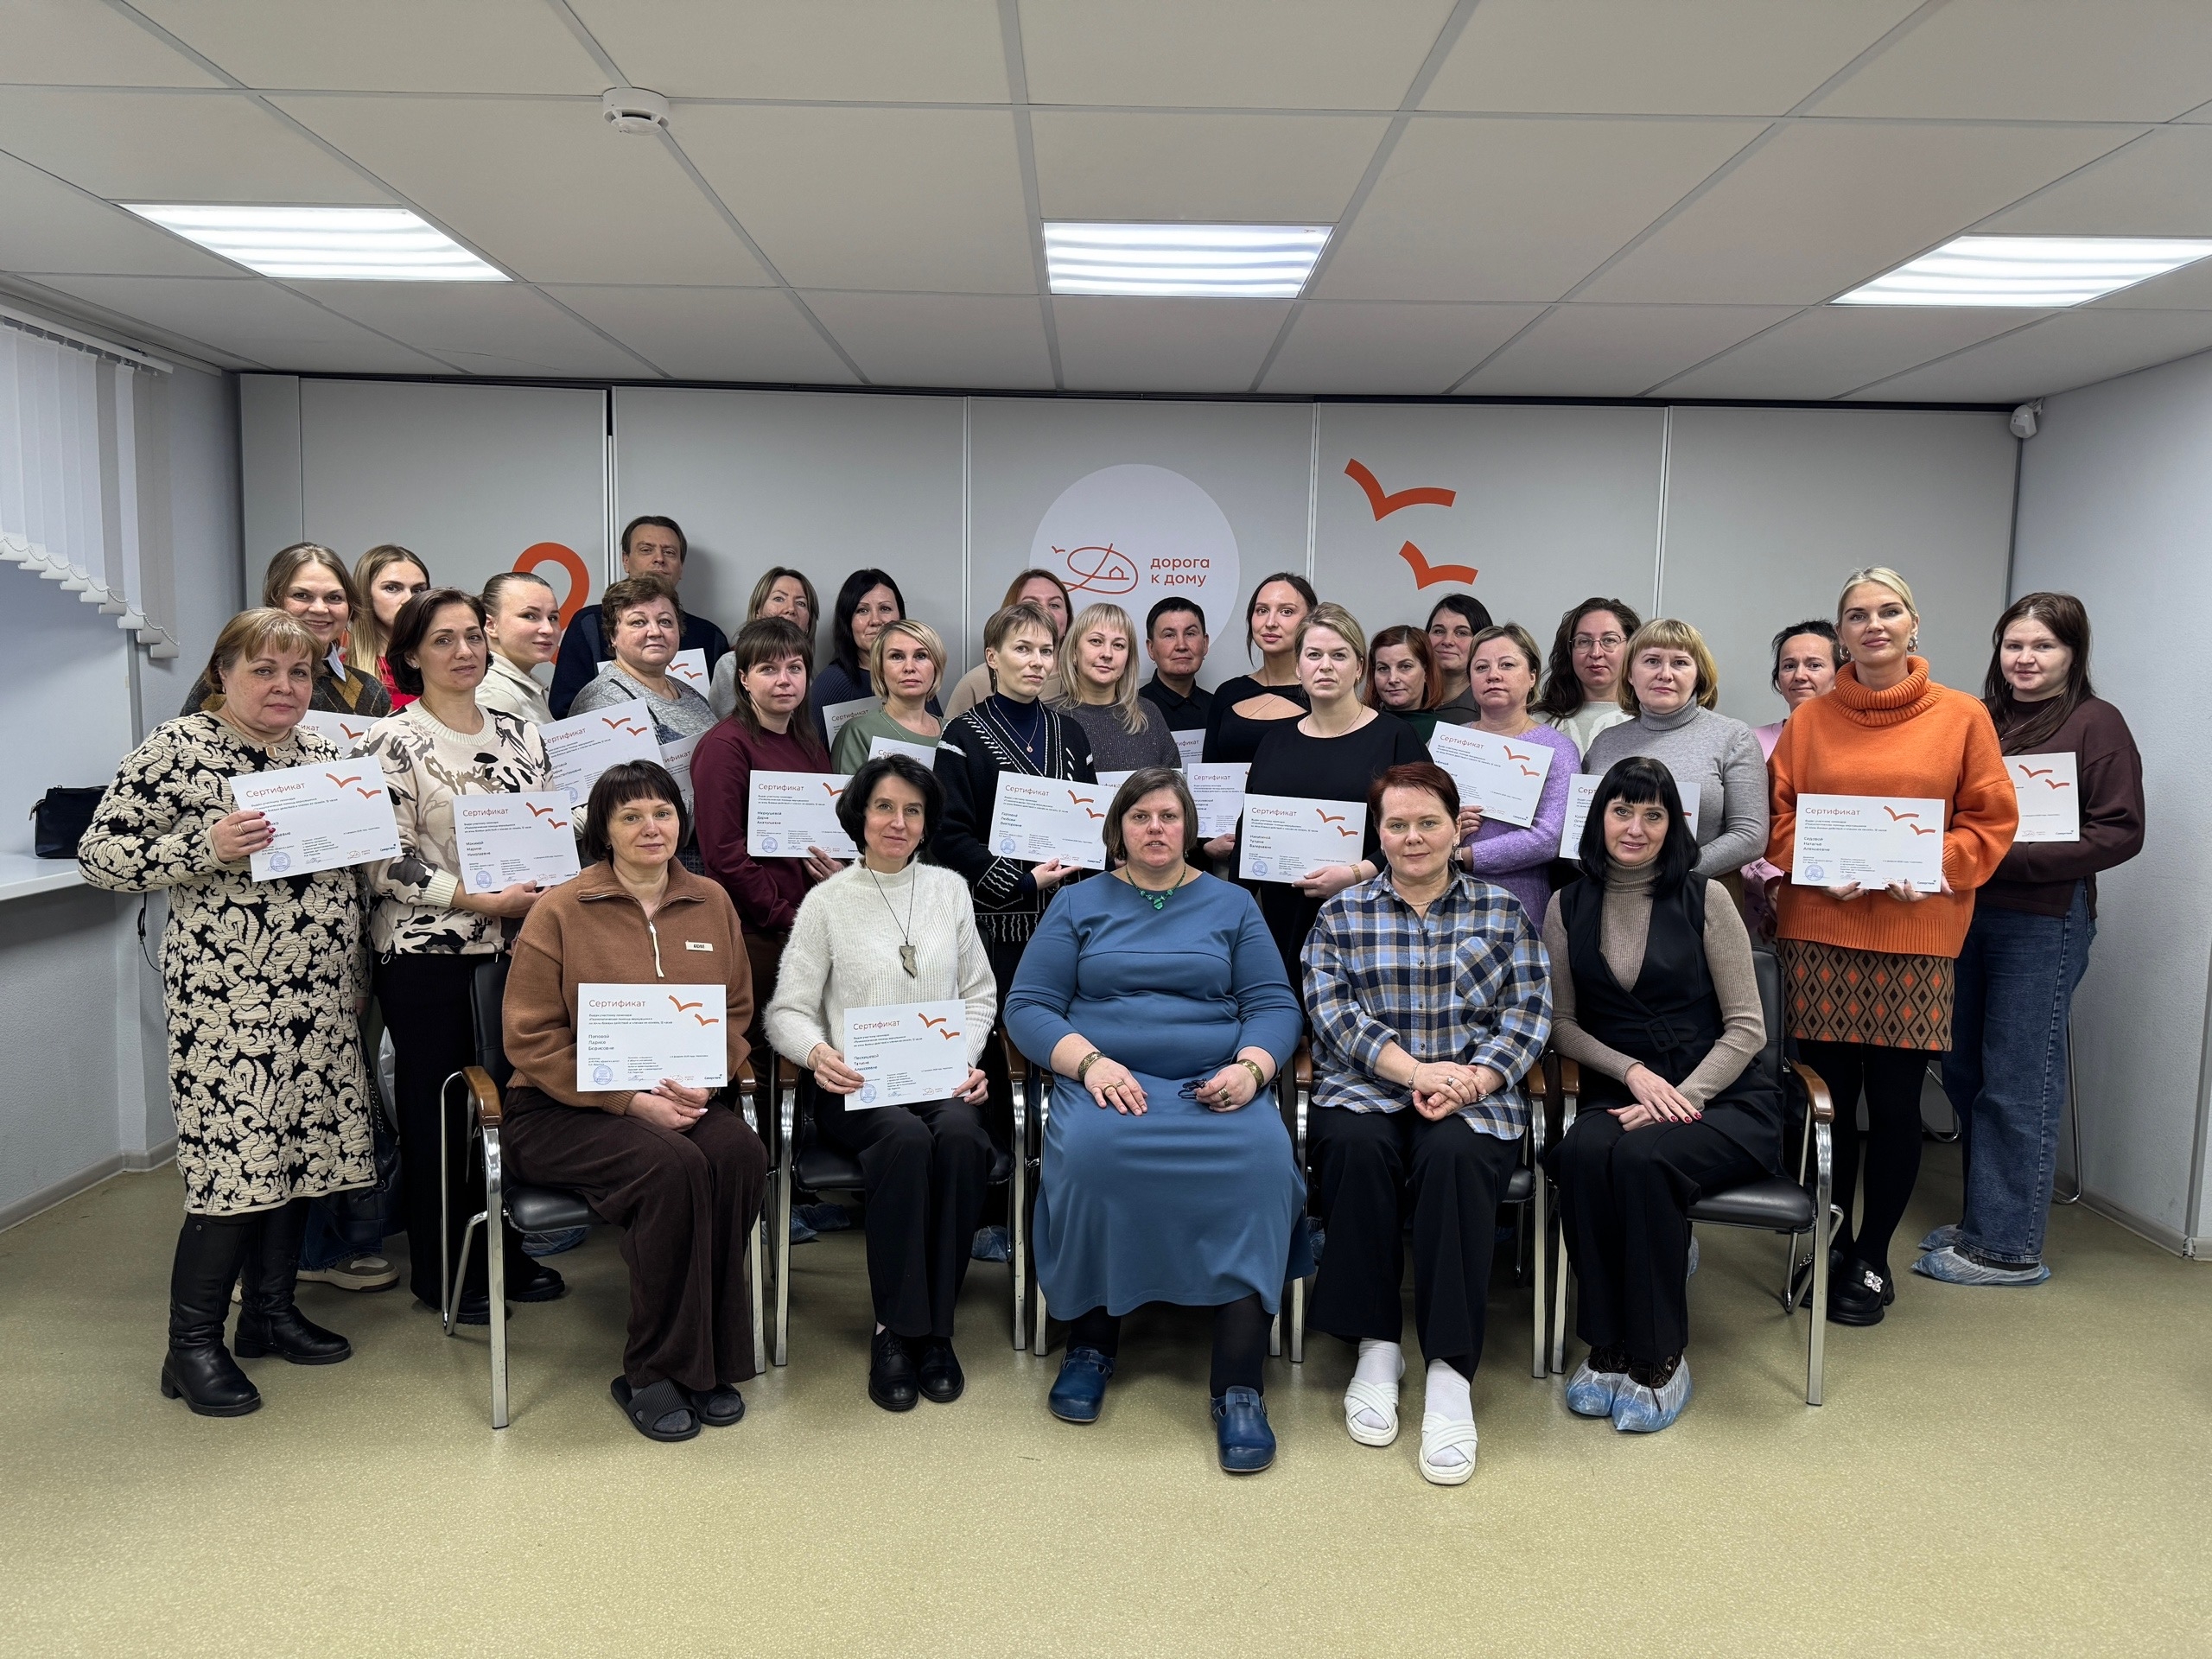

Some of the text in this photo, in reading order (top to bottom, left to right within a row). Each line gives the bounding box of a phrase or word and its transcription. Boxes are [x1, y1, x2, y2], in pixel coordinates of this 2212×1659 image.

[1150, 558, 1210, 571] дорога
[1151, 574, 1207, 588] к дому
[1440, 734, 1484, 749] Сертификат
[245, 782, 305, 798] Сертификат
[758, 783, 804, 791] Сертификат
[1005, 785, 1050, 796] Сертификат
[462, 808, 509, 817] Сертификат
[1251, 807, 1297, 817] Сертификат
[1805, 807, 1860, 816] Сертификат
[588, 1000, 646, 1008] Сертификат
[853, 1020, 900, 1031] Сертификат
